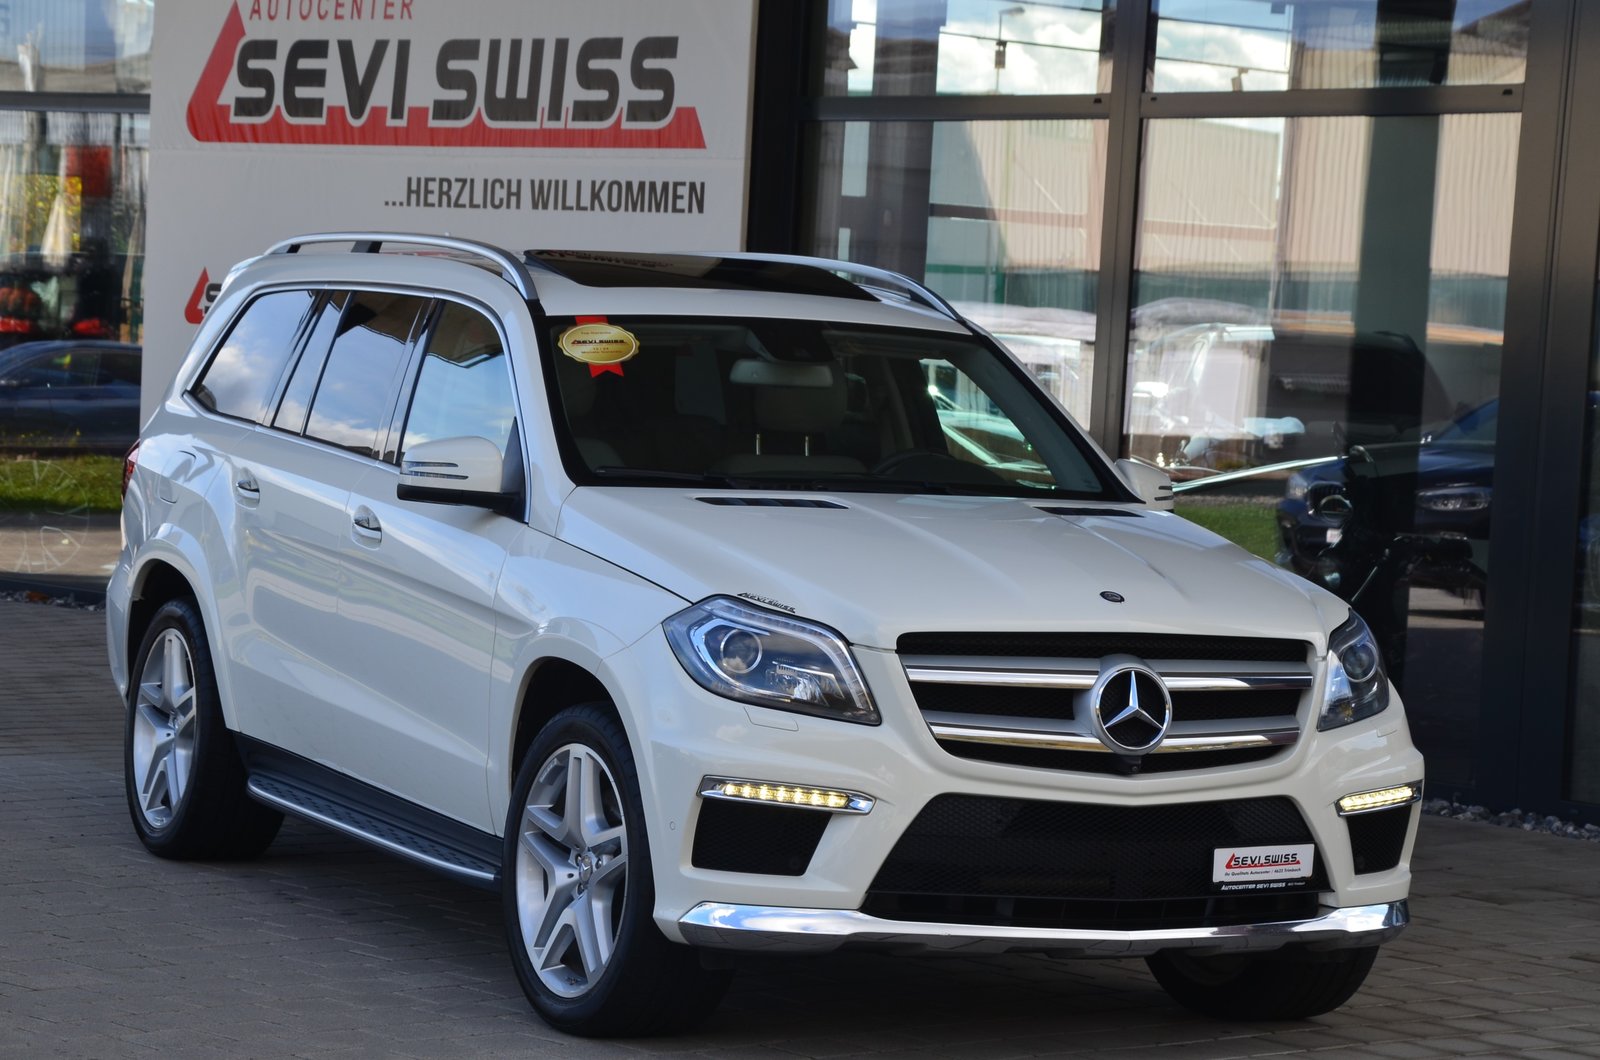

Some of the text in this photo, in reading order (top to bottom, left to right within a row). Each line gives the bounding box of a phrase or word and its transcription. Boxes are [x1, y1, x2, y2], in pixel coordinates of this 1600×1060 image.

[248, 0, 414, 21] AUTOCENTER
[233, 36, 680, 122] SEVI SWISS
[384, 176, 706, 215] ...HERZLICH WILLKOMMEN
[1233, 853, 1298, 866] SEVI SWISS
